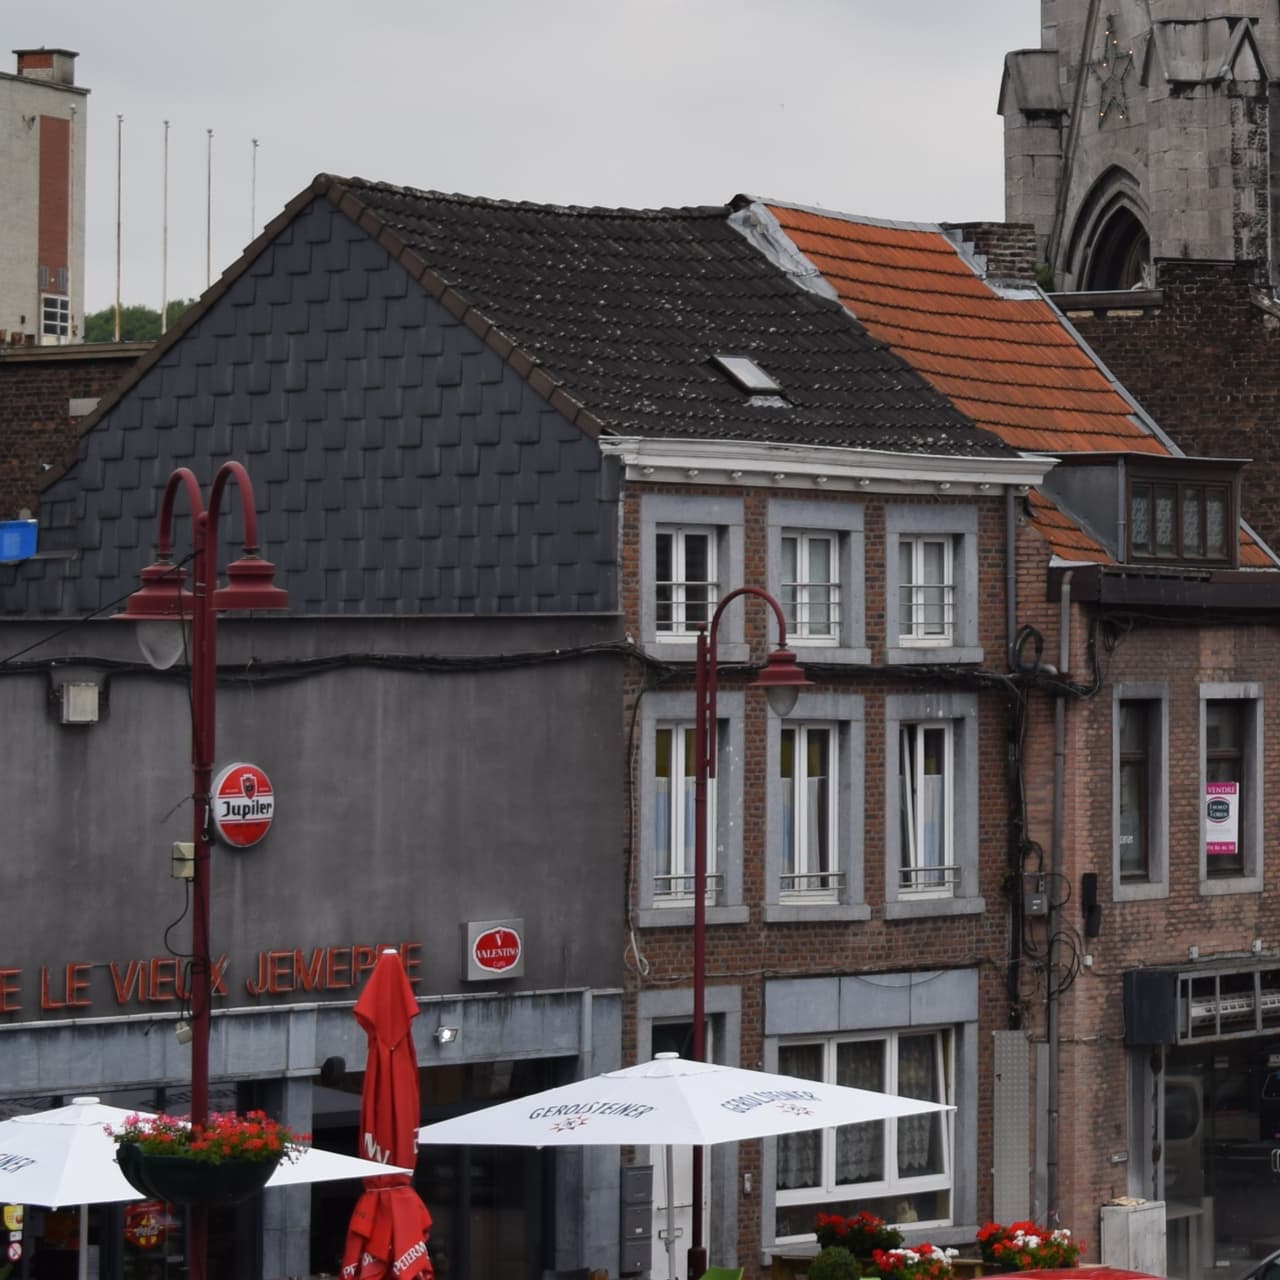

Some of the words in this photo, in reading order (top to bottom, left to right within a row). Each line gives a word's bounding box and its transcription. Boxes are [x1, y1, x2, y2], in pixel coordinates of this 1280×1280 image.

[221, 800, 272, 819] Jupiler
[41, 962, 93, 1009] LE
[109, 954, 230, 1005] VIEUX
[529, 1101, 655, 1120] GEROLSTEINER
